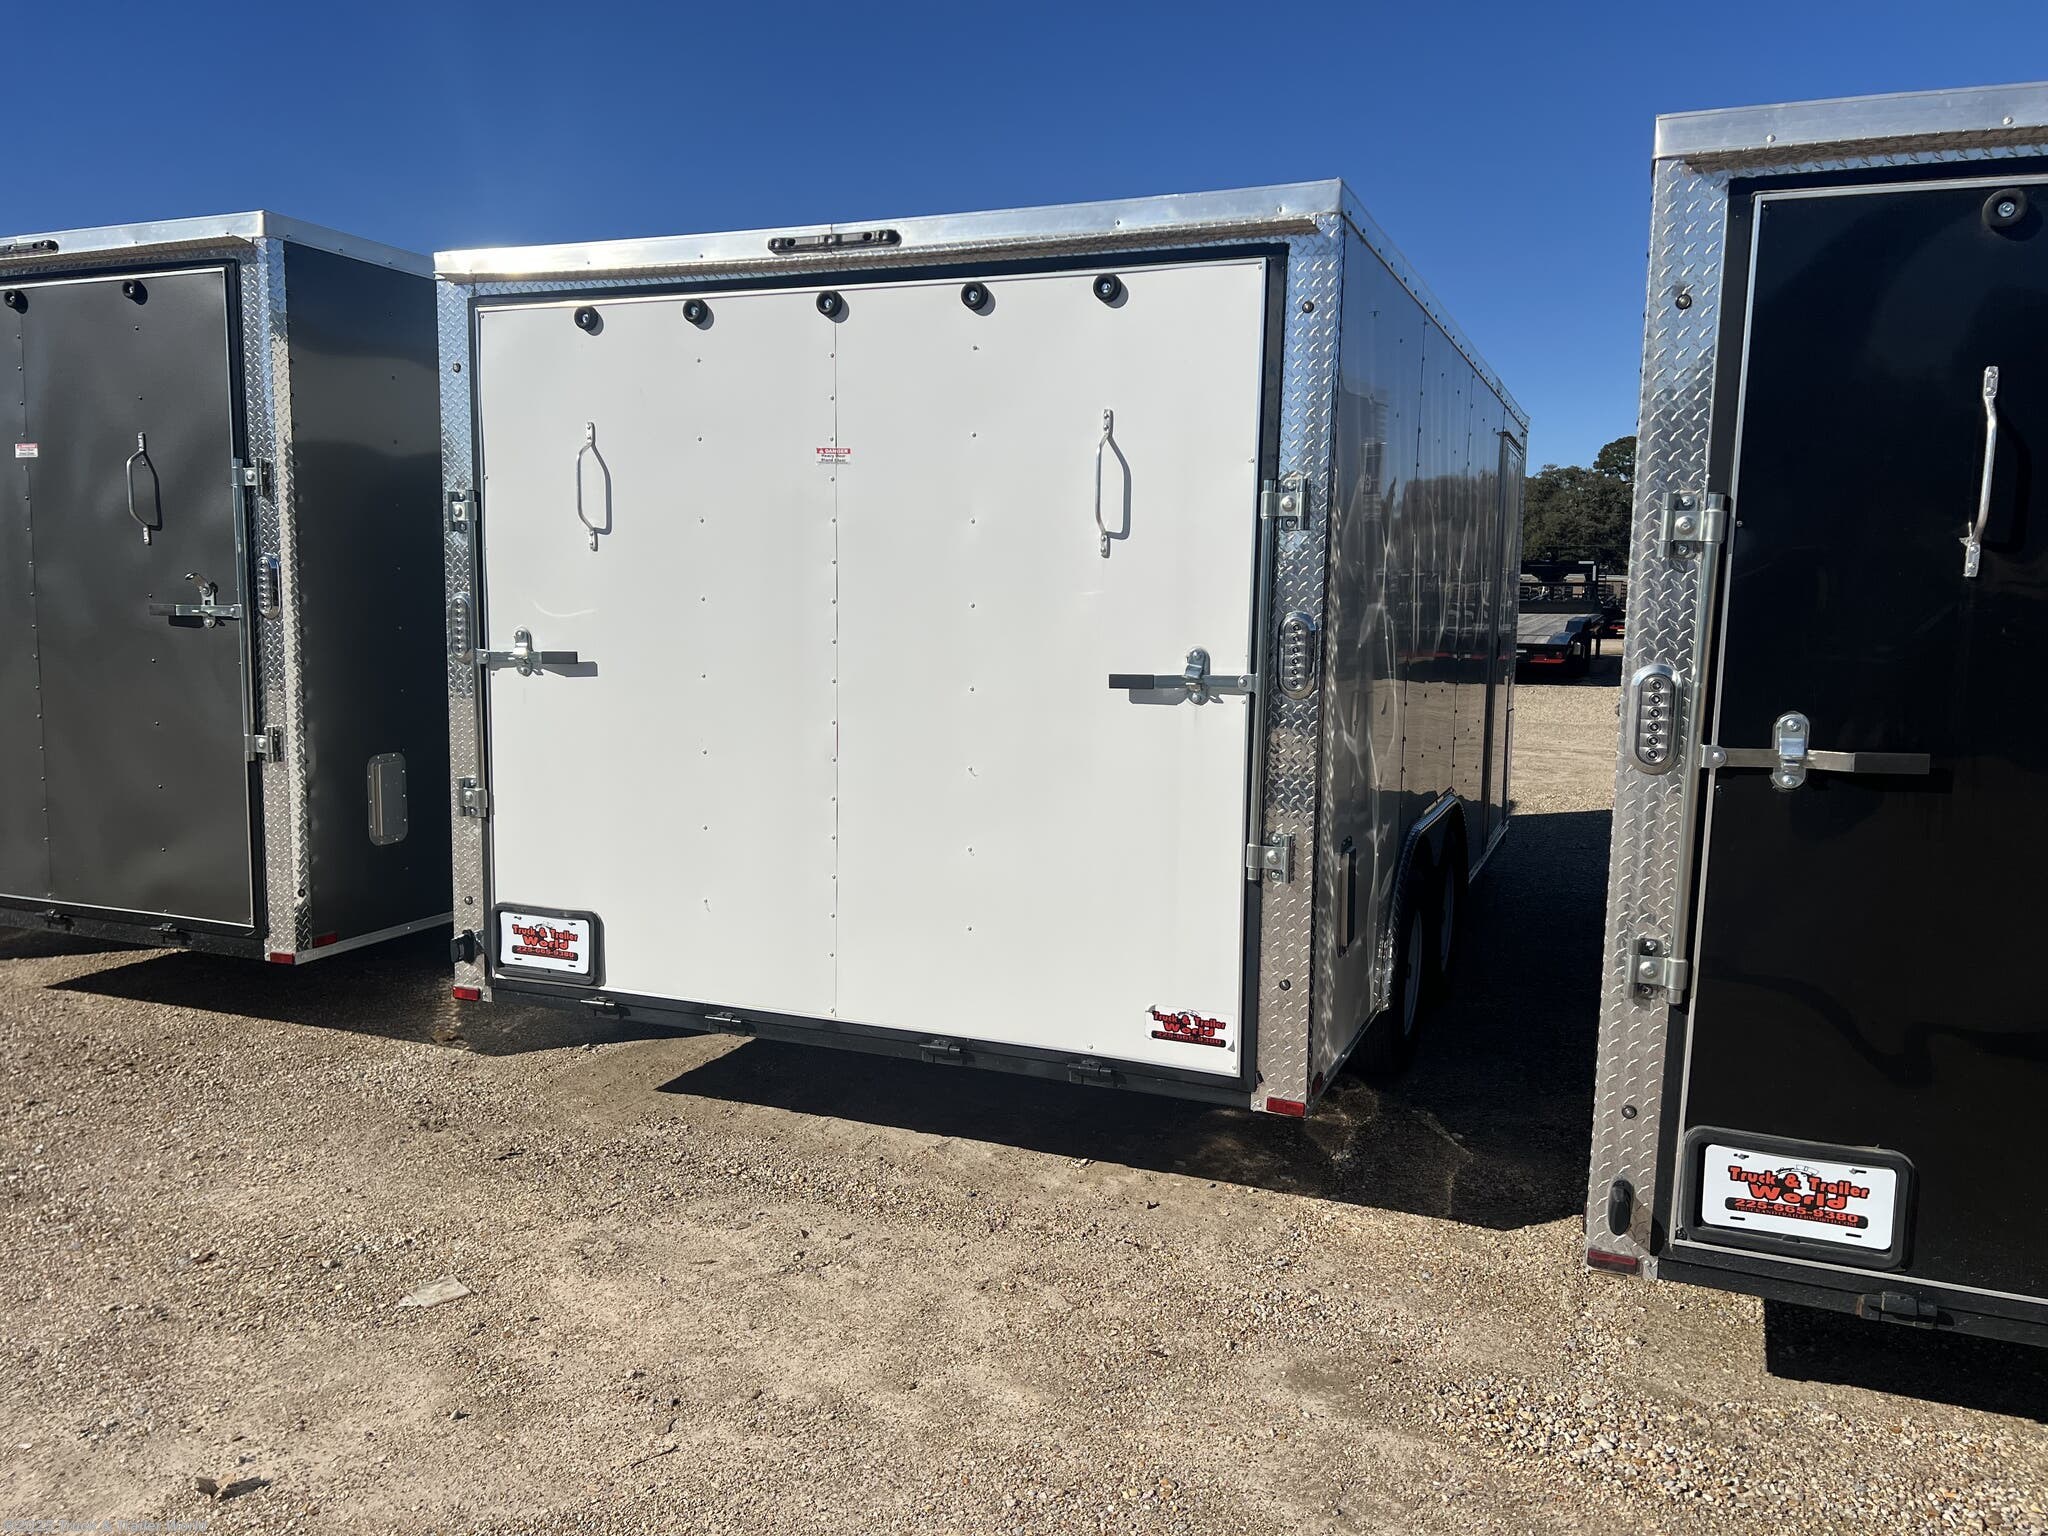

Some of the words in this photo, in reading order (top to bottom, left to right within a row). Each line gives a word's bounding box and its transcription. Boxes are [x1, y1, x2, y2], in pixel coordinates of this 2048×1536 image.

[512, 924, 537, 936] Truck
[538, 927, 548, 938] &
[550, 928, 579, 942] Trailer
[523, 935, 569, 950] World
[1153, 1011, 1178, 1023] Truck
[1181, 1014, 1191, 1025] &
[1194, 1016, 1226, 1030] Trailer
[1163, 1022, 1215, 1037] World
[1728, 1165, 1778, 1186] Truck
[1784, 1172, 1801, 1189] &
[1807, 1175, 1871, 1199] Trailer
[1748, 1183, 1848, 1211] World
[1734, 1198, 1860, 1224] 225-665-9380
